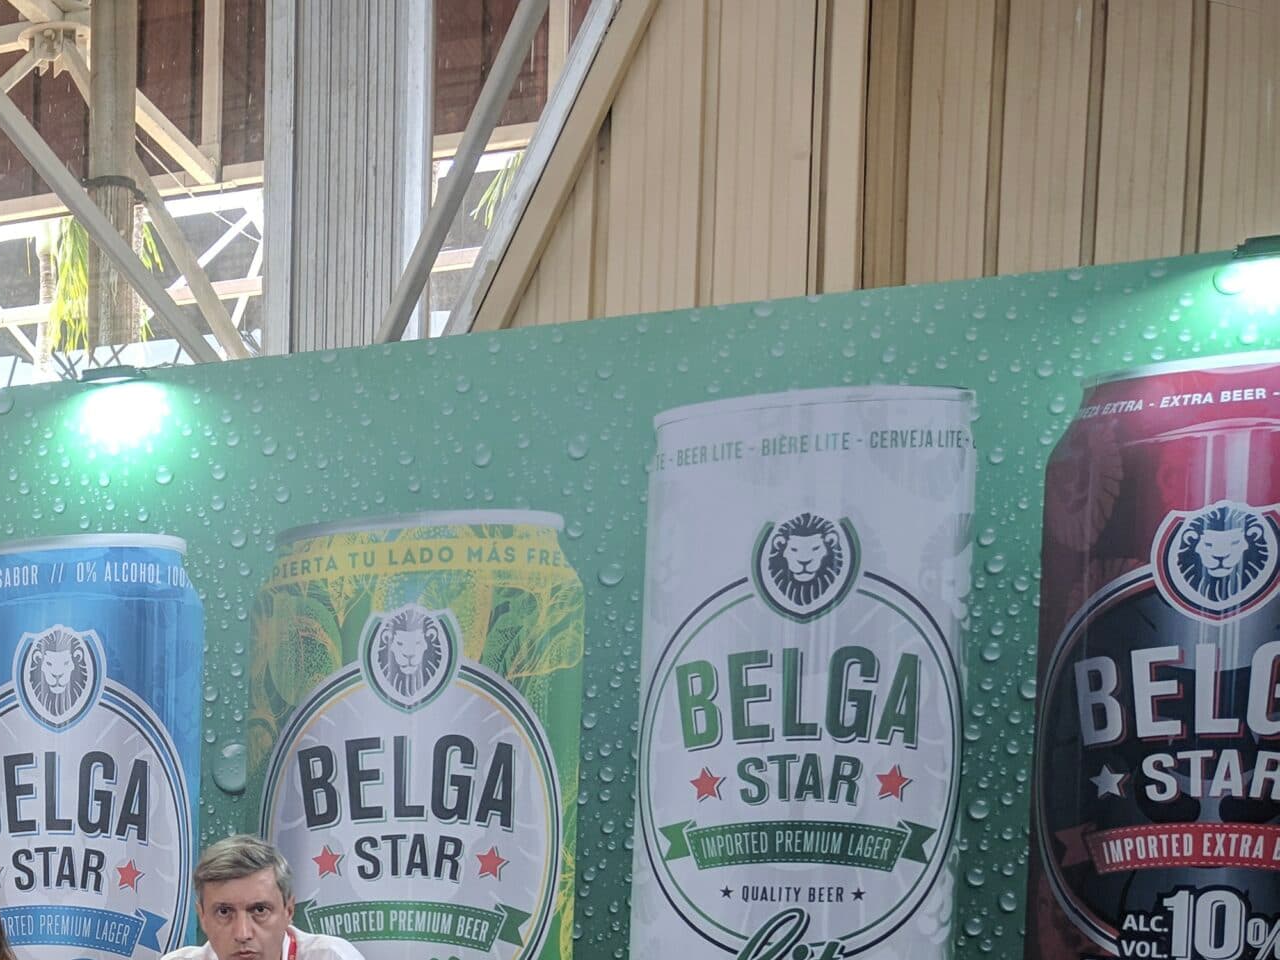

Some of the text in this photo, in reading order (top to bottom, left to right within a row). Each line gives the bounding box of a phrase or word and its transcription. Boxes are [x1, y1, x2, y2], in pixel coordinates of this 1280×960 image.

[1101, 399, 1144, 415] EXTRA
[1159, 391, 1214, 409] EXTRA
[1220, 387, 1267, 403] BEER
[676, 446, 707, 466] BEER
[712, 441, 743, 462] LITE
[761, 433, 808, 457] BIÈRE
[815, 432, 851, 453] LITE
[869, 429, 934, 449] CERVEJA
[937, 429, 963, 448] LITE
[348, 550, 376, 569] TU
[388, 545, 455, 566] LADO
[466, 540, 516, 564] MÁS
[526, 547, 568, 568] FRE
[76, 562, 97, 584] 0%
[104, 561, 162, 586] ALCOHOL
[676, 645, 920, 751] BELGA
[297, 734, 516, 832] BELGA
[736, 753, 864, 806] STAR
[1141, 749, 1280, 802] STAR
[354, 833, 464, 883] STAR
[701, 830, 891, 860] IMPORTED PREMIUM LAGER
[1102, 833, 1193, 865] IMPORTED
[1203, 833, 1264, 860] EXTRA
[12, 846, 106, 896] STAR
[741, 886, 844, 903] QUALITY BEER
[1, 914, 131, 946] ORTED PREMIUM LAGER
[320, 910, 490, 943] IMPORTED PREMIUM BEER
[1122, 914, 1169, 933] ALC.
[1122, 939, 1169, 959] VOL.
